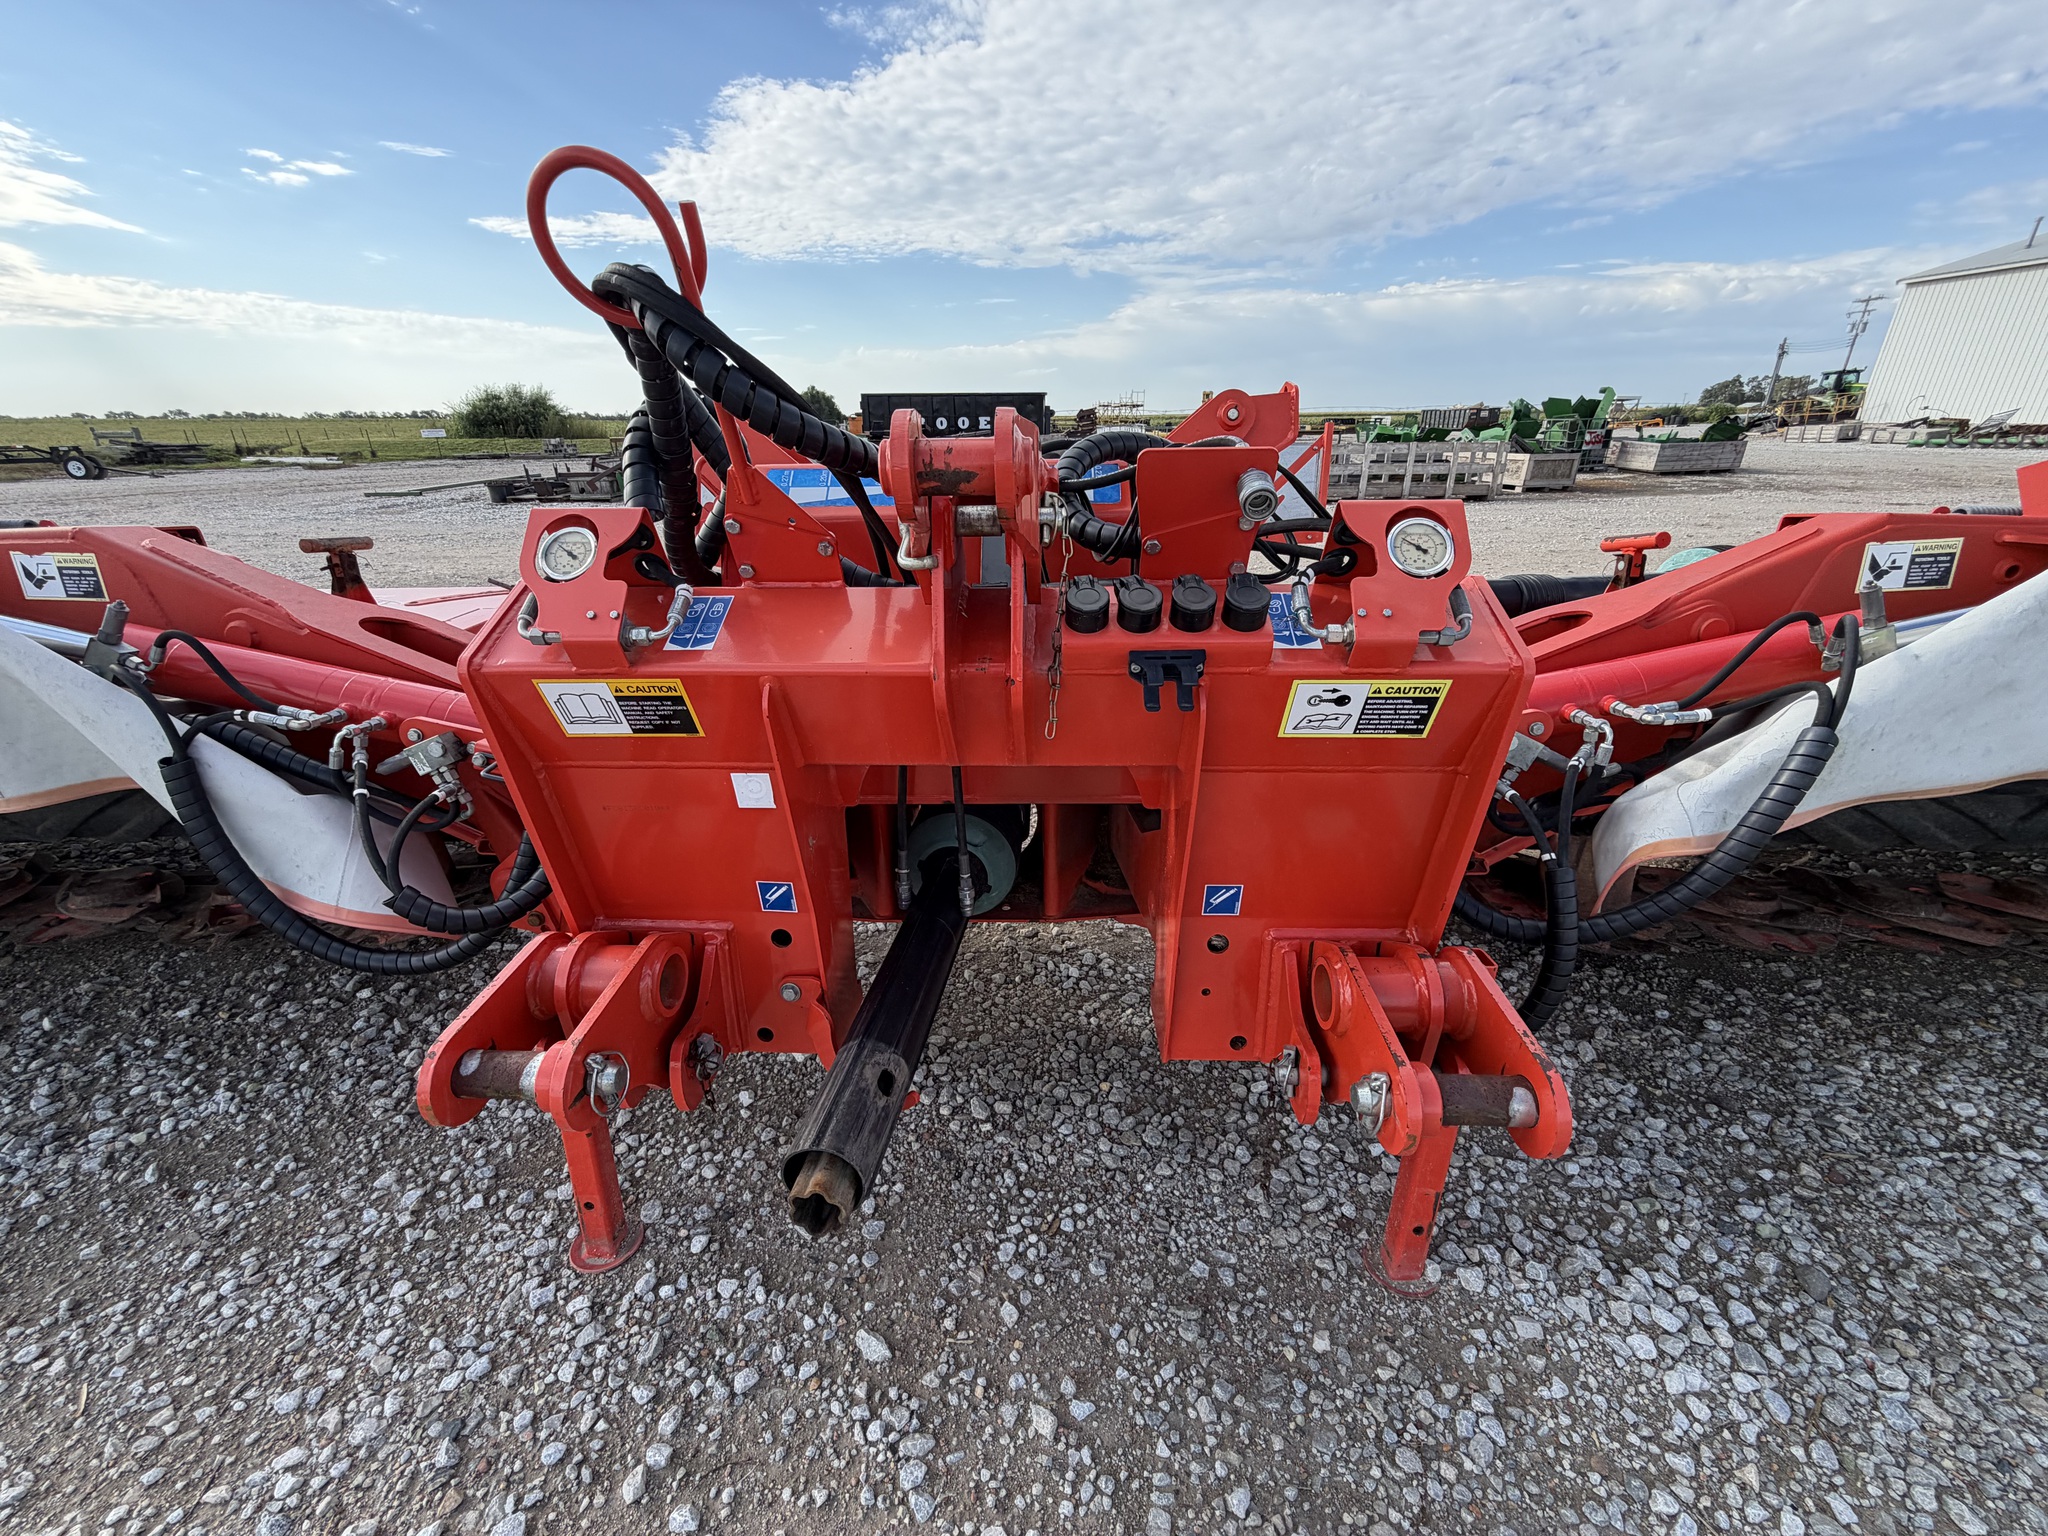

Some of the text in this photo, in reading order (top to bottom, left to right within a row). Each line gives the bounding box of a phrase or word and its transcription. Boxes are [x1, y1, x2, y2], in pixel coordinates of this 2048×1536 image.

[1921, 543, 1958, 551] WARNING
[626, 685, 678, 693] CAUTION
[1385, 686, 1442, 694] CAUTION
